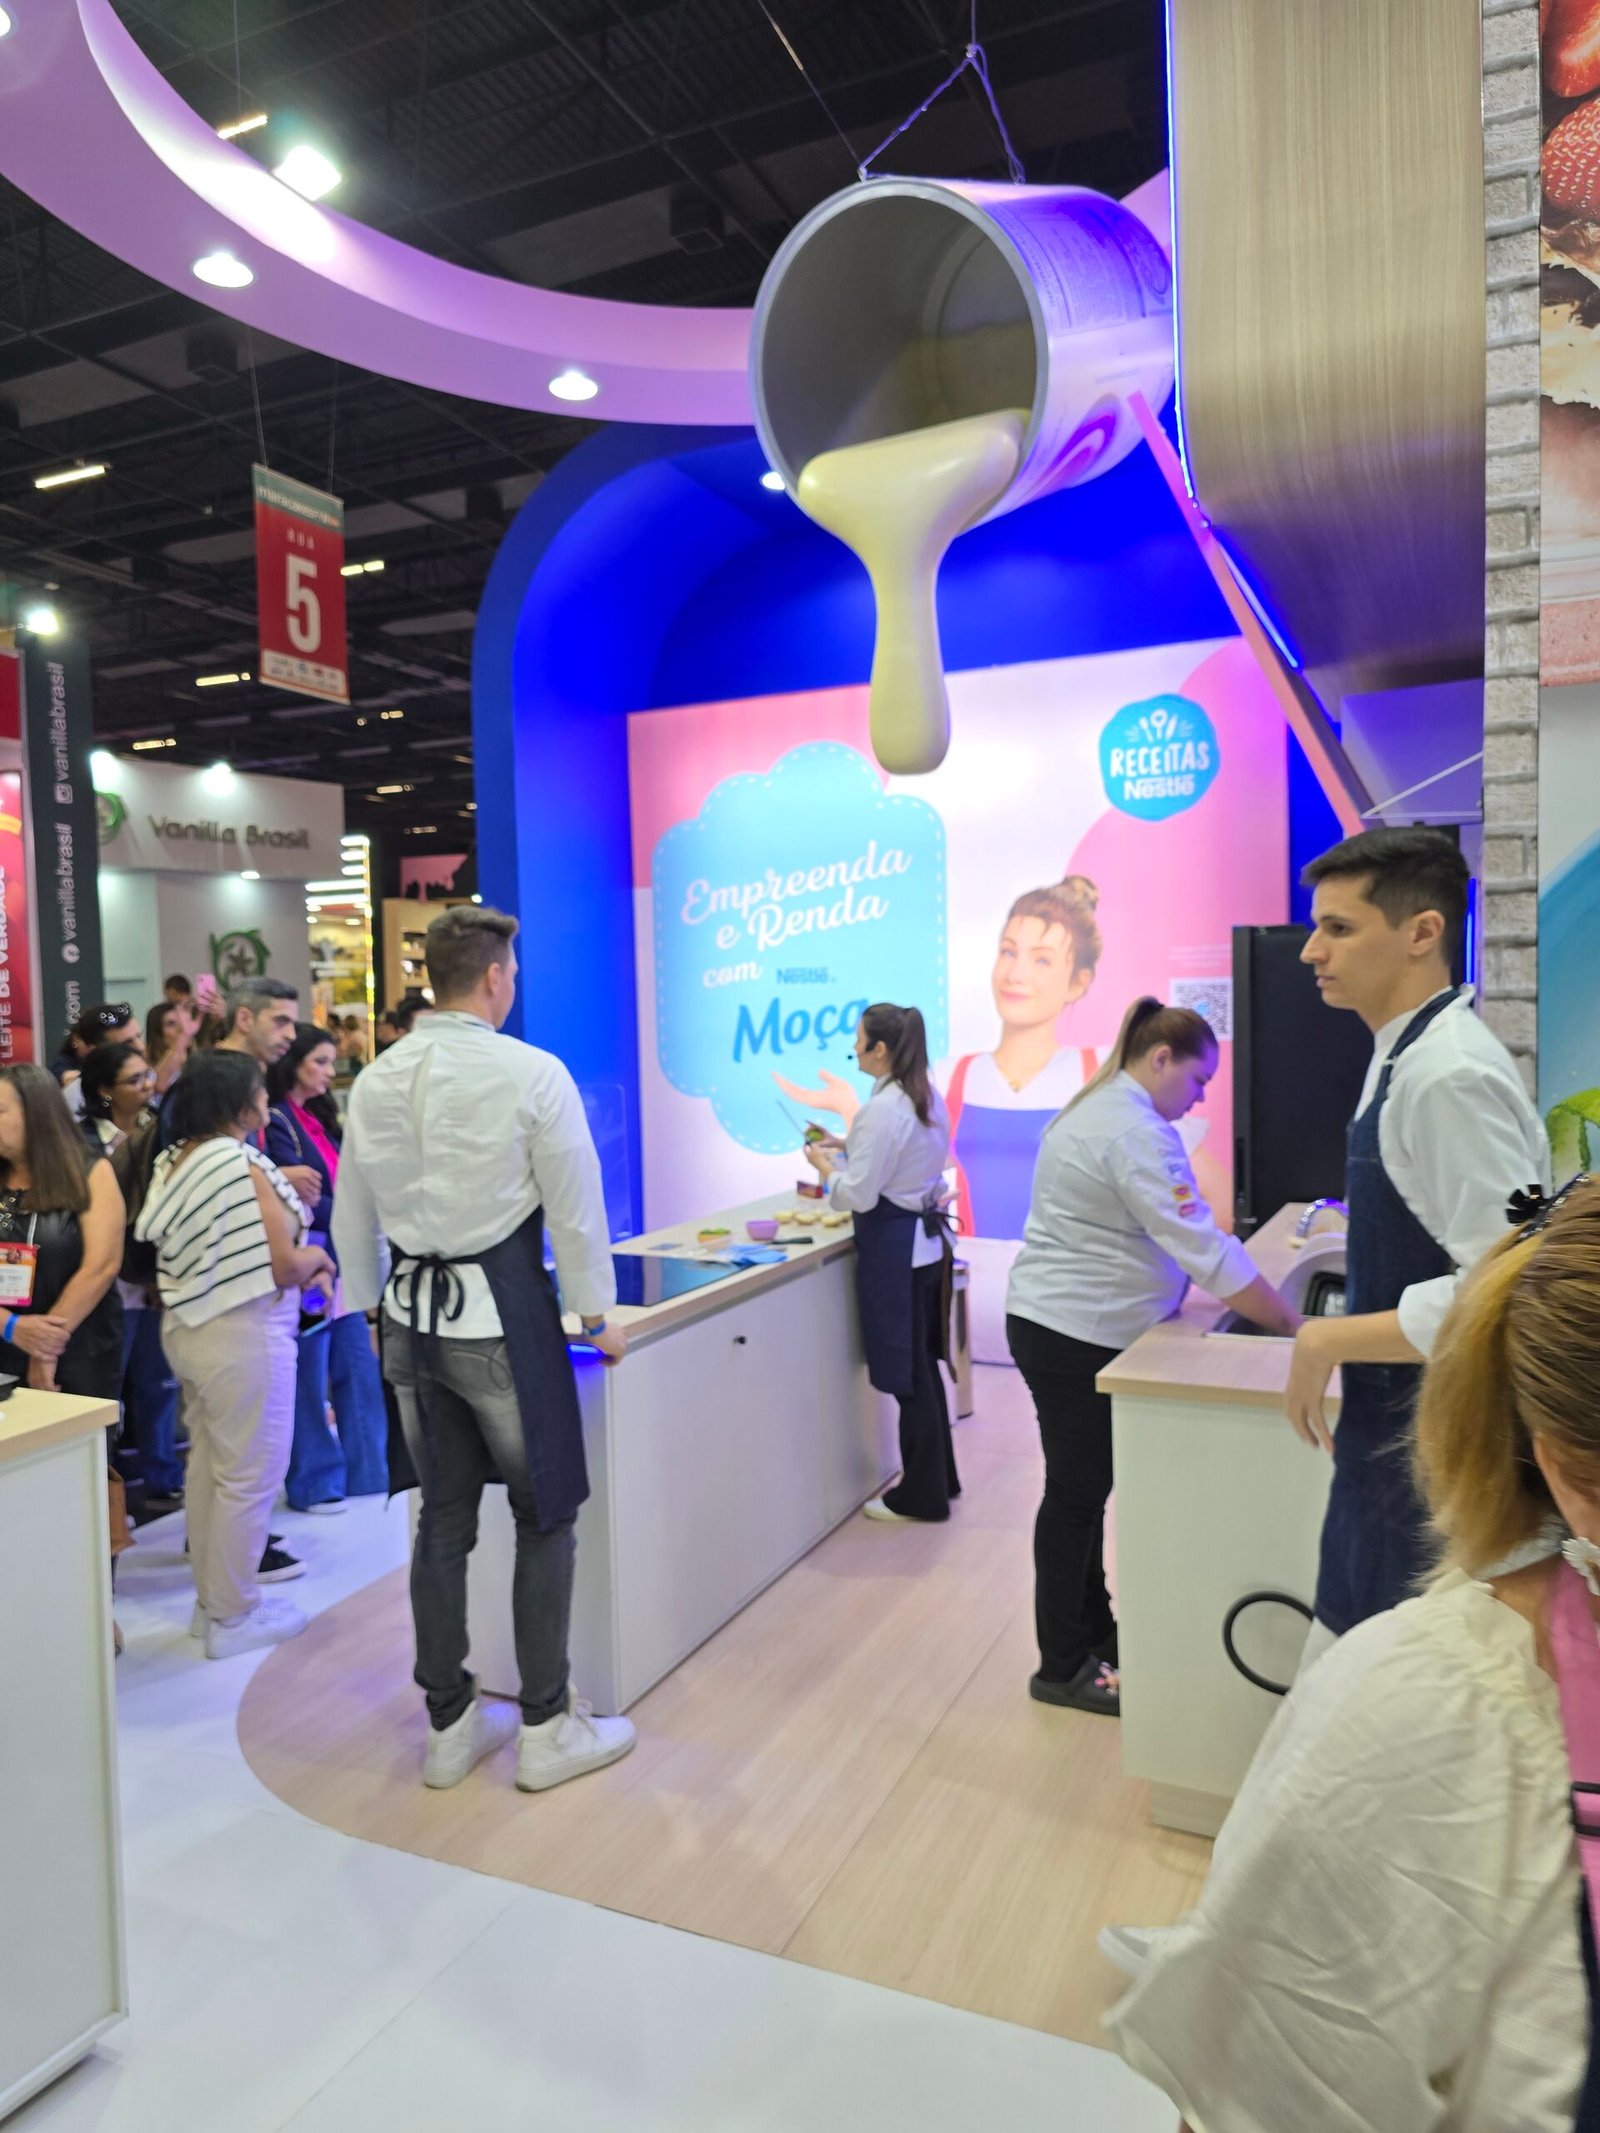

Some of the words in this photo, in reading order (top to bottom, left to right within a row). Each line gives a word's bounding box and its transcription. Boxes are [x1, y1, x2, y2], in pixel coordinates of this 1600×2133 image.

[286, 553, 322, 653] 5
[48, 661, 70, 781] vanillabrasil
[1109, 740, 1210, 778] RECEITAS
[148, 815, 237, 844] Vanilla
[246, 824, 311, 851] Brasil
[55, 823, 78, 941] vanillabrasil
[680, 840, 912, 926] Empreenda
[715, 924, 741, 950] e
[747, 885, 890, 952] Renda
[703, 960, 764, 988] com
[732, 997, 870, 1063] Moça
